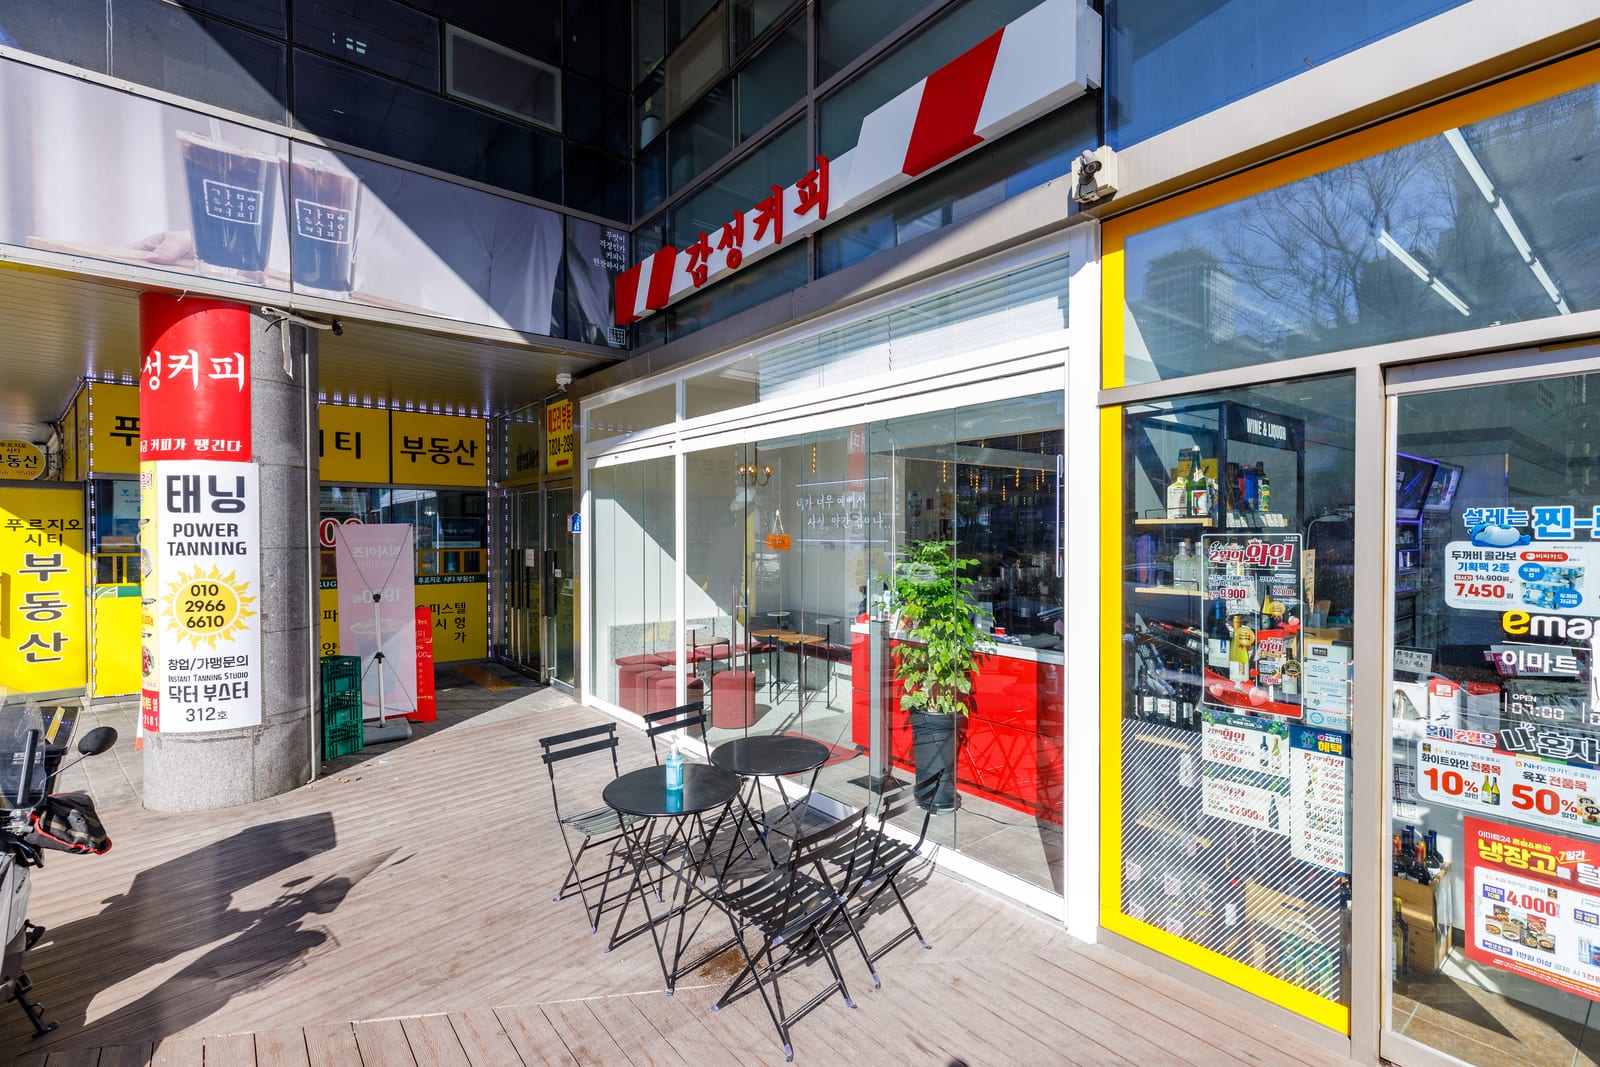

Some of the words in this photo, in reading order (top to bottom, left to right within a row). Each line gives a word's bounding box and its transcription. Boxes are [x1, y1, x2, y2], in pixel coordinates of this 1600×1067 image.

[685, 155, 830, 288] 감성커피
[140, 349, 246, 392] 성커피
[1246, 417, 1262, 436] WINE
[1268, 423, 1287, 441] LIQUOR
[150, 437, 188, 451] 커피가
[194, 438, 242, 452] 땡긴다
[400, 435, 478, 466] 부동산
[166, 474, 246, 513] 태닝
[816, 492, 834, 510] 너무
[4, 518, 83, 532] 푸르지오
[1464, 507, 1529, 527] 설레는
[173, 522, 239, 538] POWER
[24, 533, 63, 547] 시티
[167, 541, 247, 556] TANNING
[1245, 543, 1294, 566] 와인
[1451, 550, 1483, 561] 두꺼비
[1484, 550, 1517, 561] 콜라보
[1457, 562, 1489, 573] 기획팩
[1492, 563, 1510, 573] 2종
[418, 576, 441, 584] 푸르지오
[456, 575, 475, 583] 부동산
[190, 584, 219, 597] 010
[17, 552, 69, 664] 부동산
[185, 600, 226, 613] 2966
[416, 602, 467, 616] 피스텔
[186, 615, 225, 629] 6610
[168, 655, 249, 671] 창업/가맹문의
[1312, 664, 1330, 673] SSG
[1501, 650, 1580, 674] 이마트
[168, 685, 198, 703] 닥터
[203, 681, 249, 702] 부스터
[1512, 693, 1537, 702] OPEN
[185, 706, 228, 722] 312호
[1511, 702, 1565, 720] 07:00
[1421, 752, 1469, 770] 화이트와인
[1470, 761, 1502, 776] 전품목
[1423, 767, 1479, 796] 10%
[1522, 771, 1547, 785] 육포
[1548, 775, 1588, 792] 전품목
[1464, 791, 1479, 800] 할인
[1511, 783, 1578, 816] 50%
[1561, 811, 1578, 821] 할인
[1478, 830, 1511, 844] 이마트24
[1478, 838, 1557, 877] 냉장고
[1515, 950, 1535, 962] 1만원
[1536, 957, 1553, 968] 이상
